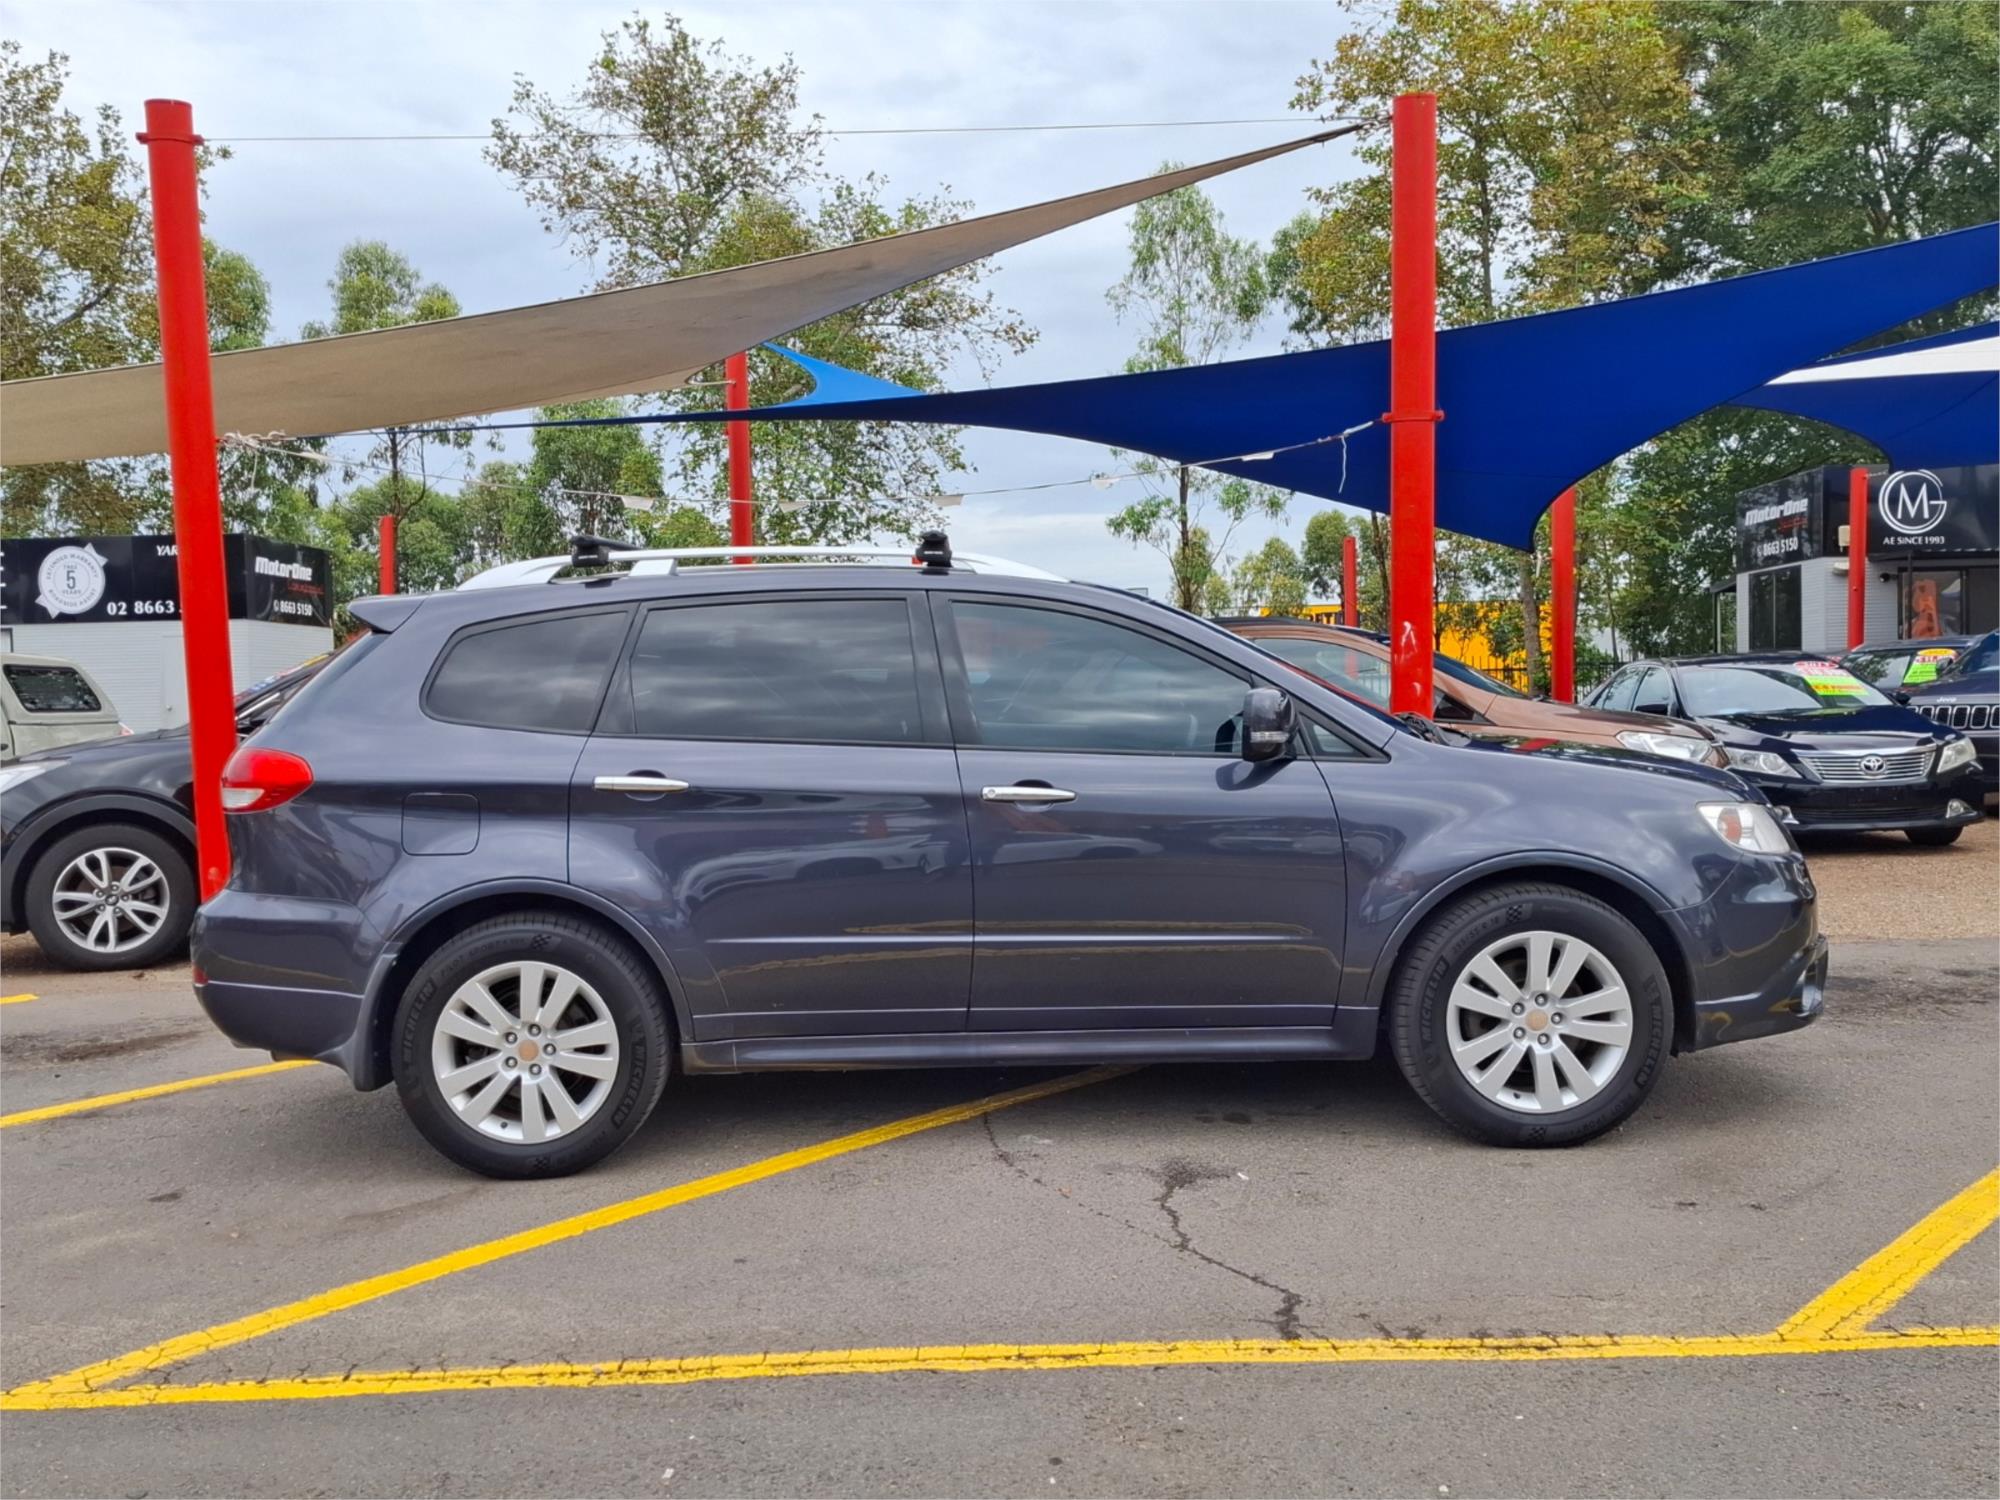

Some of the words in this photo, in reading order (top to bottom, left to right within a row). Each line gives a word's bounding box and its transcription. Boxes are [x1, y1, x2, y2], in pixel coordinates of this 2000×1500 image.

[1744, 498, 1808, 526] MotorOne
[1781, 536, 1799, 553] 5150
[1883, 536, 1896, 545] AE
[1897, 536, 1923, 545] SINCE
[1925, 535, 1945, 545] 1993
[254, 556, 313, 581] MotorOne
[66, 569, 76, 590] 5
[106, 601, 128, 616] 02
[133, 599, 175, 615] 8663
[1421, 960, 1446, 1041] MICHELIN
